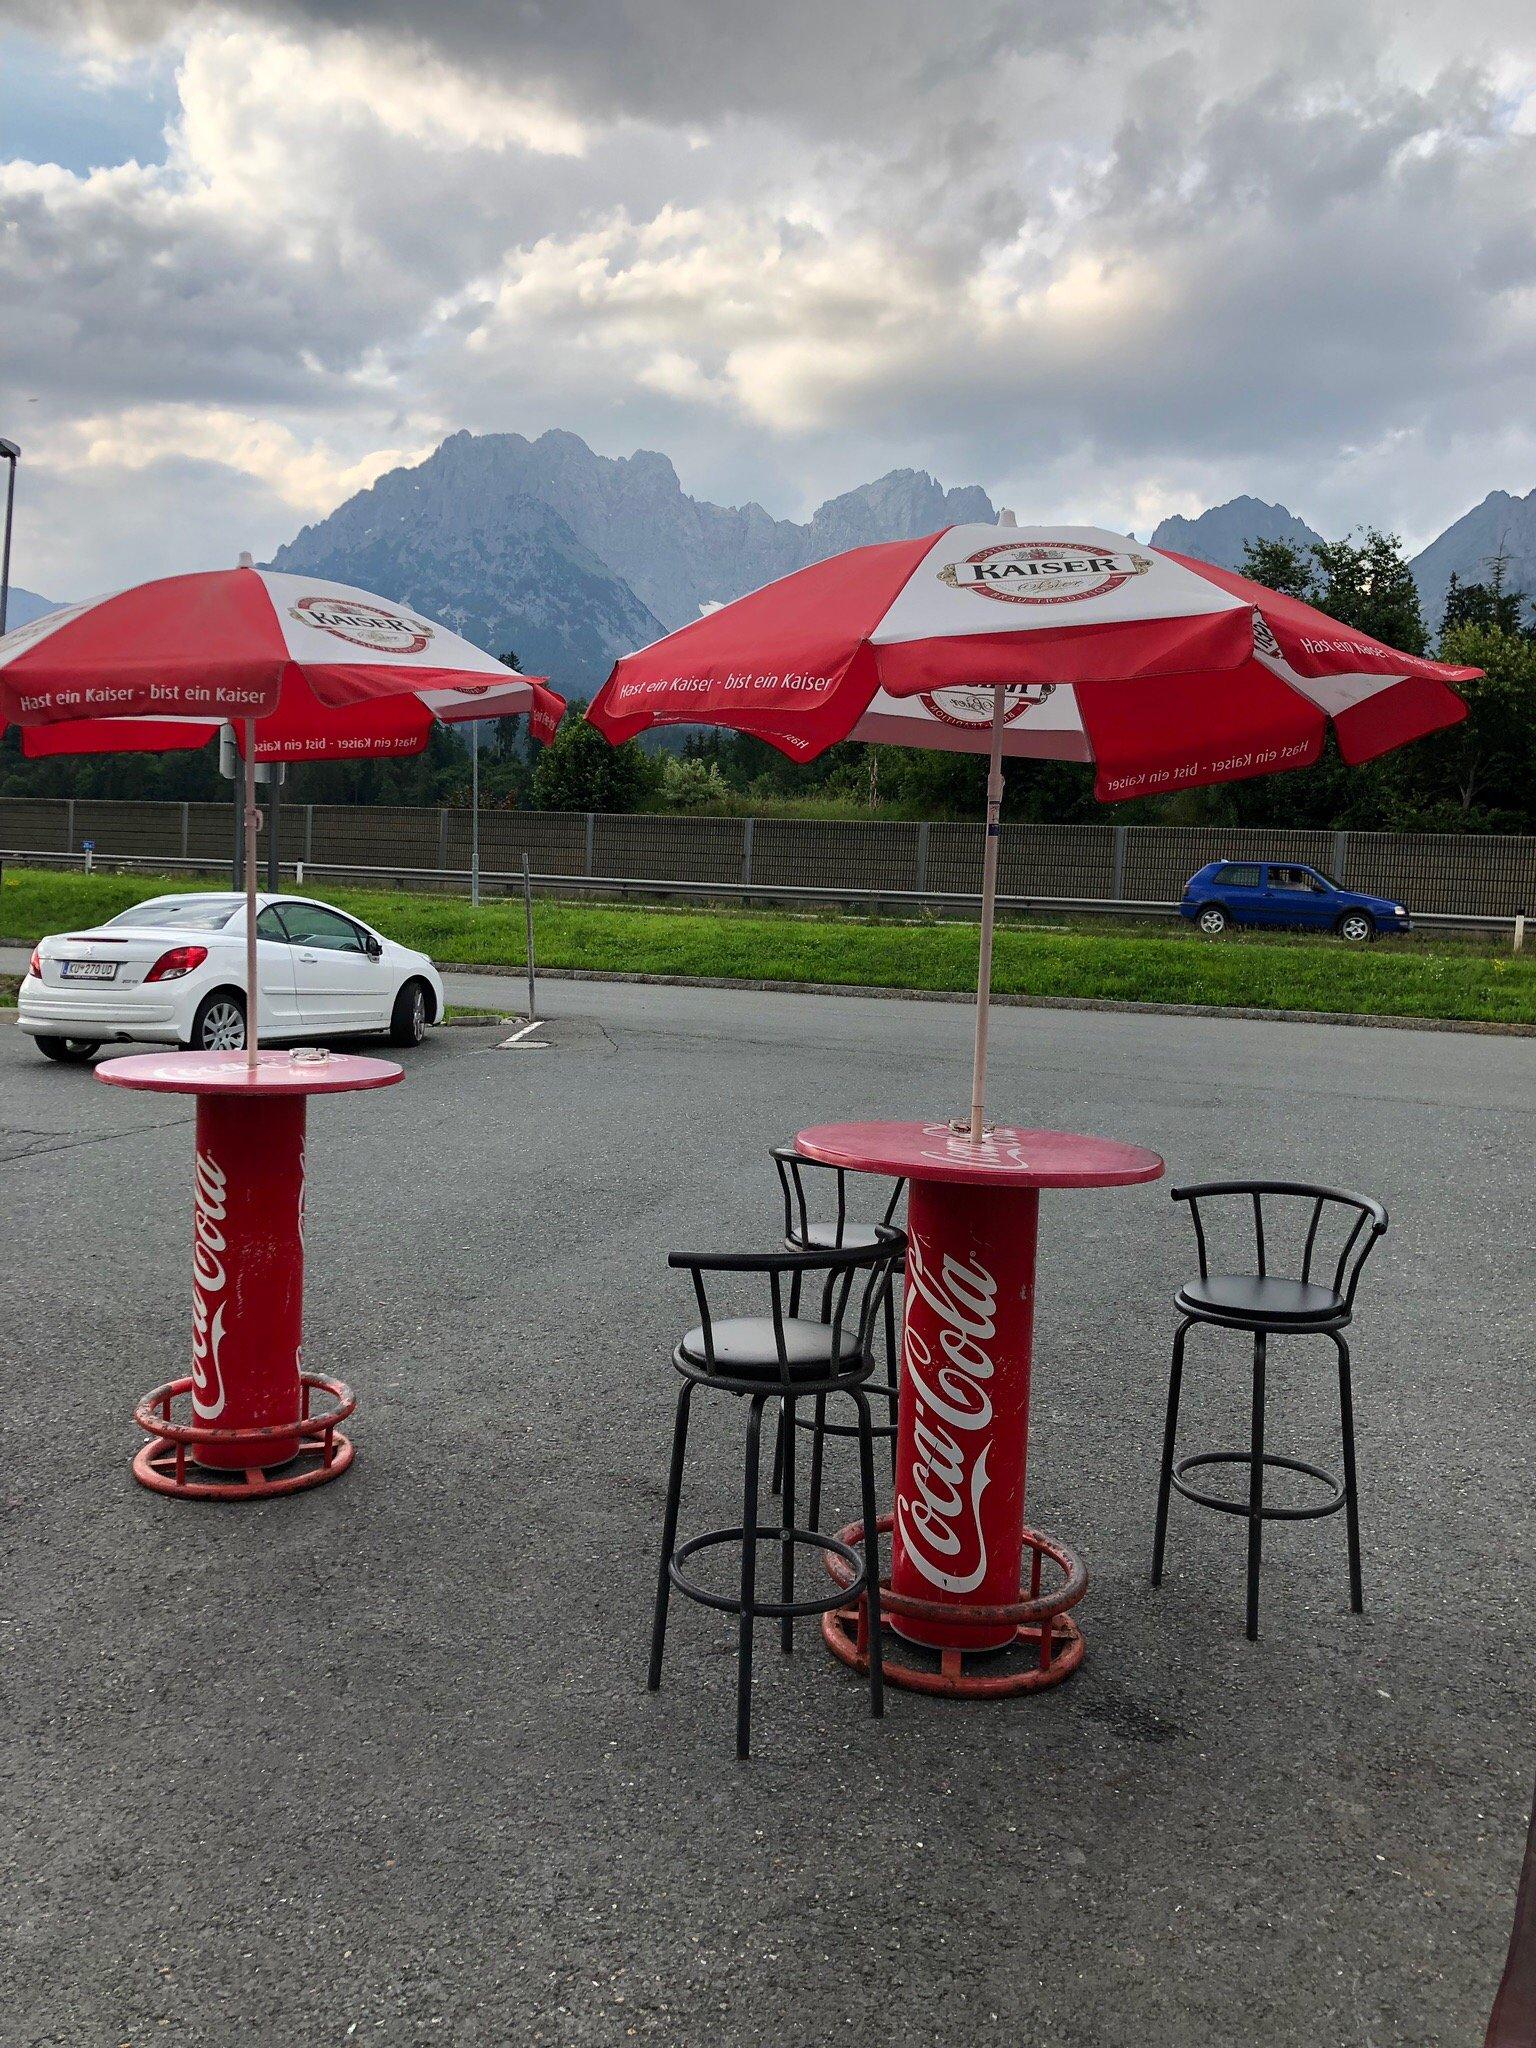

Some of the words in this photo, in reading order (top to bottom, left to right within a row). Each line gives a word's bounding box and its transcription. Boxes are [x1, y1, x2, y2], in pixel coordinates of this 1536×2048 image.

[973, 557, 1119, 581] KAISER
[308, 611, 412, 632] KAISER
[1300, 637, 1334, 654] Hast
[1335, 640, 1354, 653] ein
[20, 692, 51, 711] Hast
[56, 690, 80, 705] ein
[85, 686, 133, 702] Kaiser
[150, 684, 180, 700] bist
[185, 686, 210, 701] ein
[216, 687, 266, 704] Kaiser
[619, 681, 644, 700] Hast
[646, 678, 669, 693] ein
[670, 675, 714, 692] Kaiser
[724, 673, 752, 690] bist
[754, 672, 778, 688] ein
[780, 672, 832, 692] Kaiser
[898, 1225, 998, 1593] Coca-Cola
